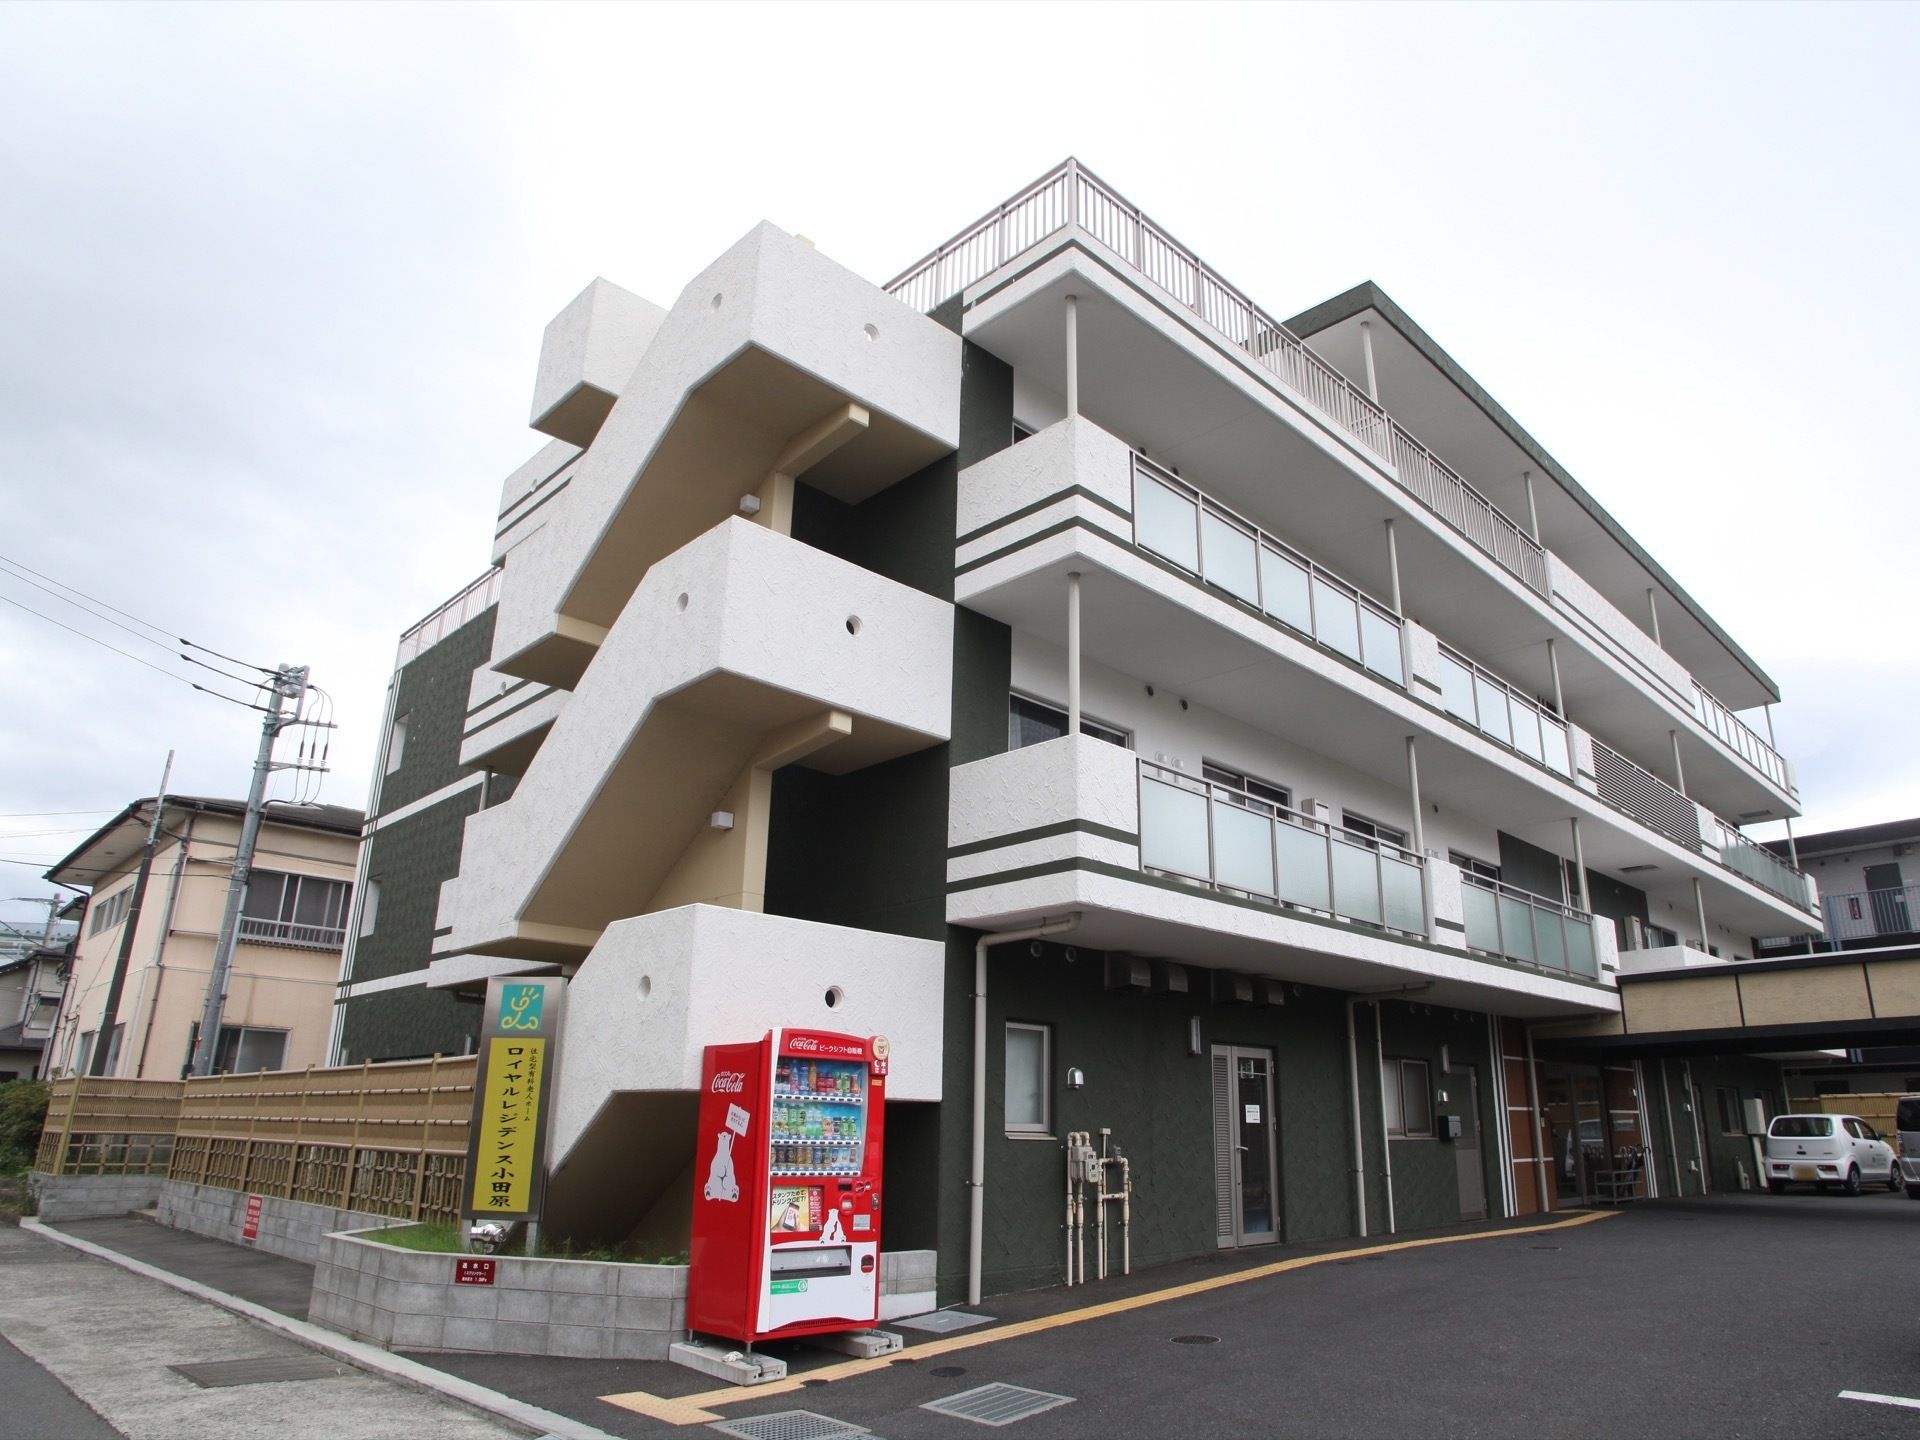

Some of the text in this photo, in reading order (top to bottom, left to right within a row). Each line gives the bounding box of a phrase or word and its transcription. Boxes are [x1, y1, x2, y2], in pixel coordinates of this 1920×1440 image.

[488, 1047, 524, 1208] ロイヤルレジデンス小田原
